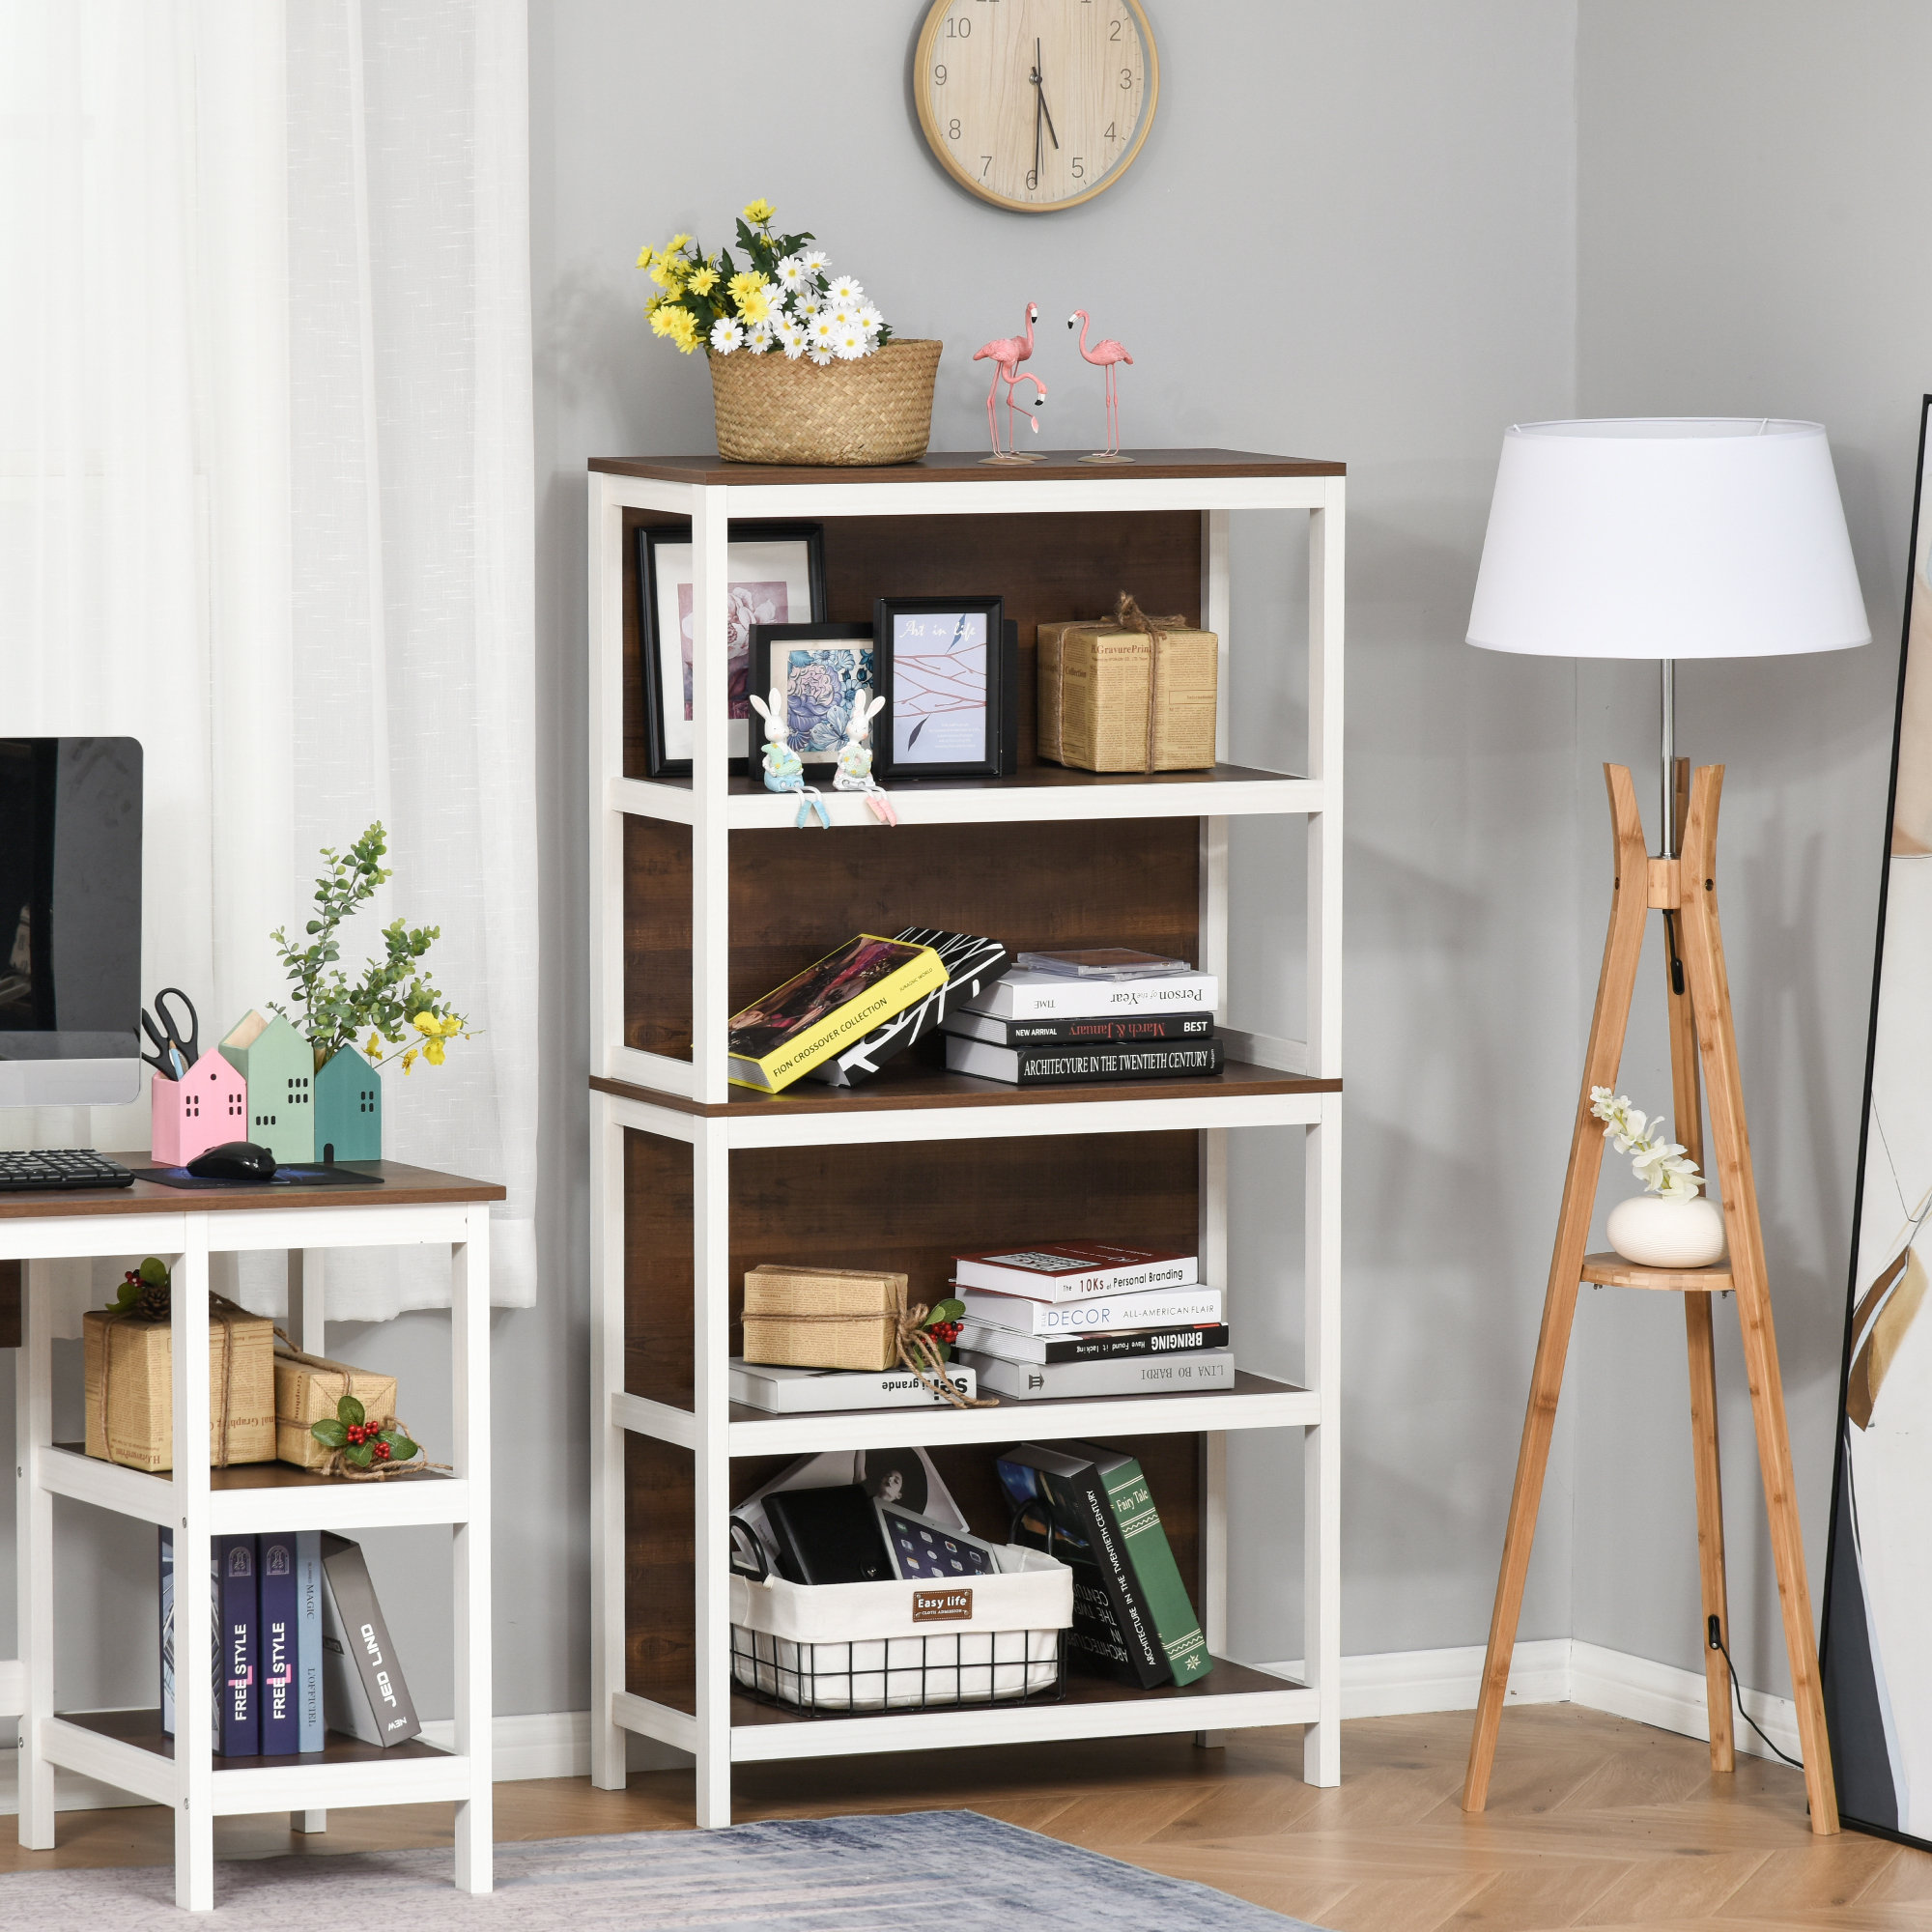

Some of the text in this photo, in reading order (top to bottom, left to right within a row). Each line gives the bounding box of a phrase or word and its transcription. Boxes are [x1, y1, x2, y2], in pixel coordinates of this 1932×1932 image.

[946, 17, 971, 38] 10
[1109, 20, 1122, 42] 2
[934, 64, 947, 86] 9
[1120, 69, 1132, 90] 3
[949, 118, 961, 140] 8
[1104, 122, 1117, 142] 4
[980, 156, 992, 177] 7
[1071, 156, 1084, 178] 5
[1026, 169, 1037, 190] 6
[1034, 1000, 1056, 1009] TIME
[1110, 992, 1139, 1005] Year
[1159, 989, 1203, 1002] Person
[1031, 1028, 1058, 1037] ARRIVAL
[1068, 1022, 1165, 1038] March & January
[1183, 1021, 1208, 1032] BEST
[773, 997, 888, 1078] FION CROSSOVER COLLECTION
[1090, 1056, 1099, 1072] IN
[1100, 1055, 1118, 1072] THE
[1119, 1052, 1167, 1071] TWENTIETH
[1168, 1050, 1208, 1068] CENTURY
[1080, 1278, 1104, 1293] 10Ks
[1114, 1273, 1147, 1288] Personal
[1149, 1268, 1183, 1283] Branding
[1048, 1308, 1111, 1326] DECOR
[1122, 1305, 1214, 1318] ALL-AMERICAN FLAIR
[1076, 1345, 1099, 1353] lacking
[1151, 1331, 1203, 1350] BRINGING
[1141, 1365, 1224, 1380] LINA BO BARDI
[882, 1378, 919, 1392] grande
[1116, 1489, 1149, 1512] Fairy Tale
[1086, 1490, 1156, 1665] ARCHITECTURE IN THE TWENTIETH CENTURY
[306, 1584, 315, 1620] MAGIC
[918, 1596, 967, 1609] Easy life
[235, 1623, 247, 1721] FREE STYLE
[272, 1622, 286, 1719] FREE STYLE
[360, 1623, 397, 1708] JED LIND
[307, 1667, 317, 1728] L'OFFICIEL
[387, 1716, 408, 1732] NEW
